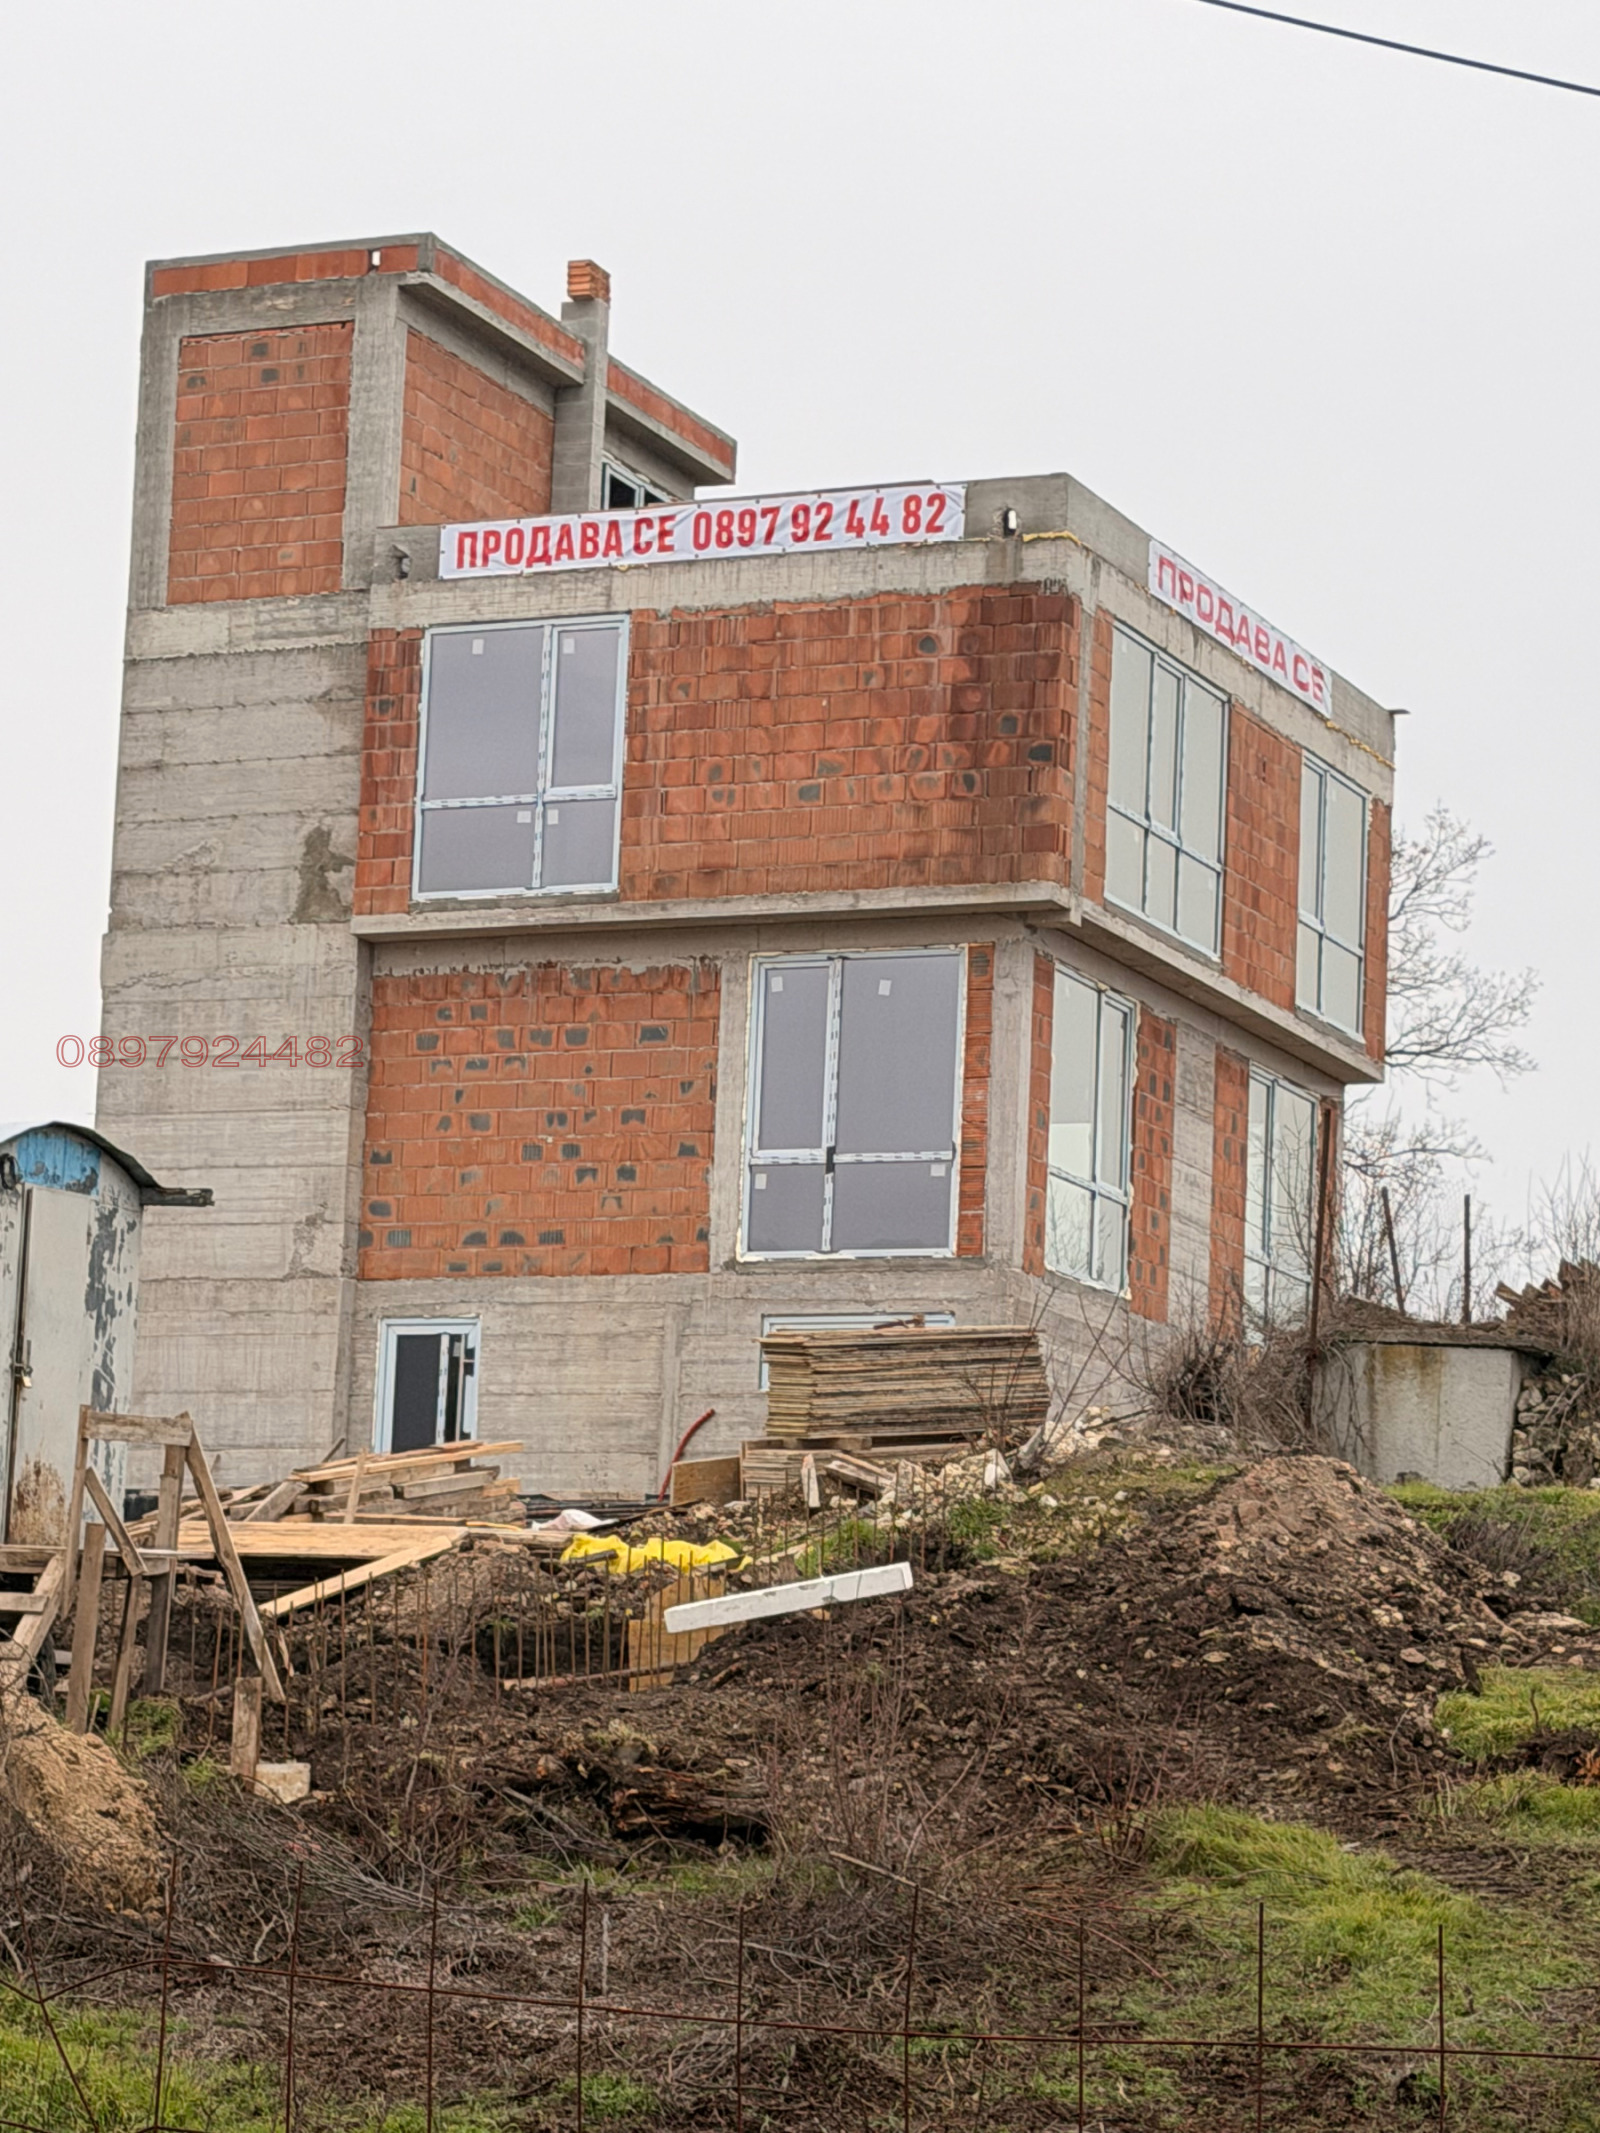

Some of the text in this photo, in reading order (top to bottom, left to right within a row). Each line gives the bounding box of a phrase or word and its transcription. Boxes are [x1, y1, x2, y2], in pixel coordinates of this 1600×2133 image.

[455, 492, 947, 569] ПРОДАВА СЕ 0897 92 44 82
[1157, 554, 1325, 704] ПРОДАВА СЕ
